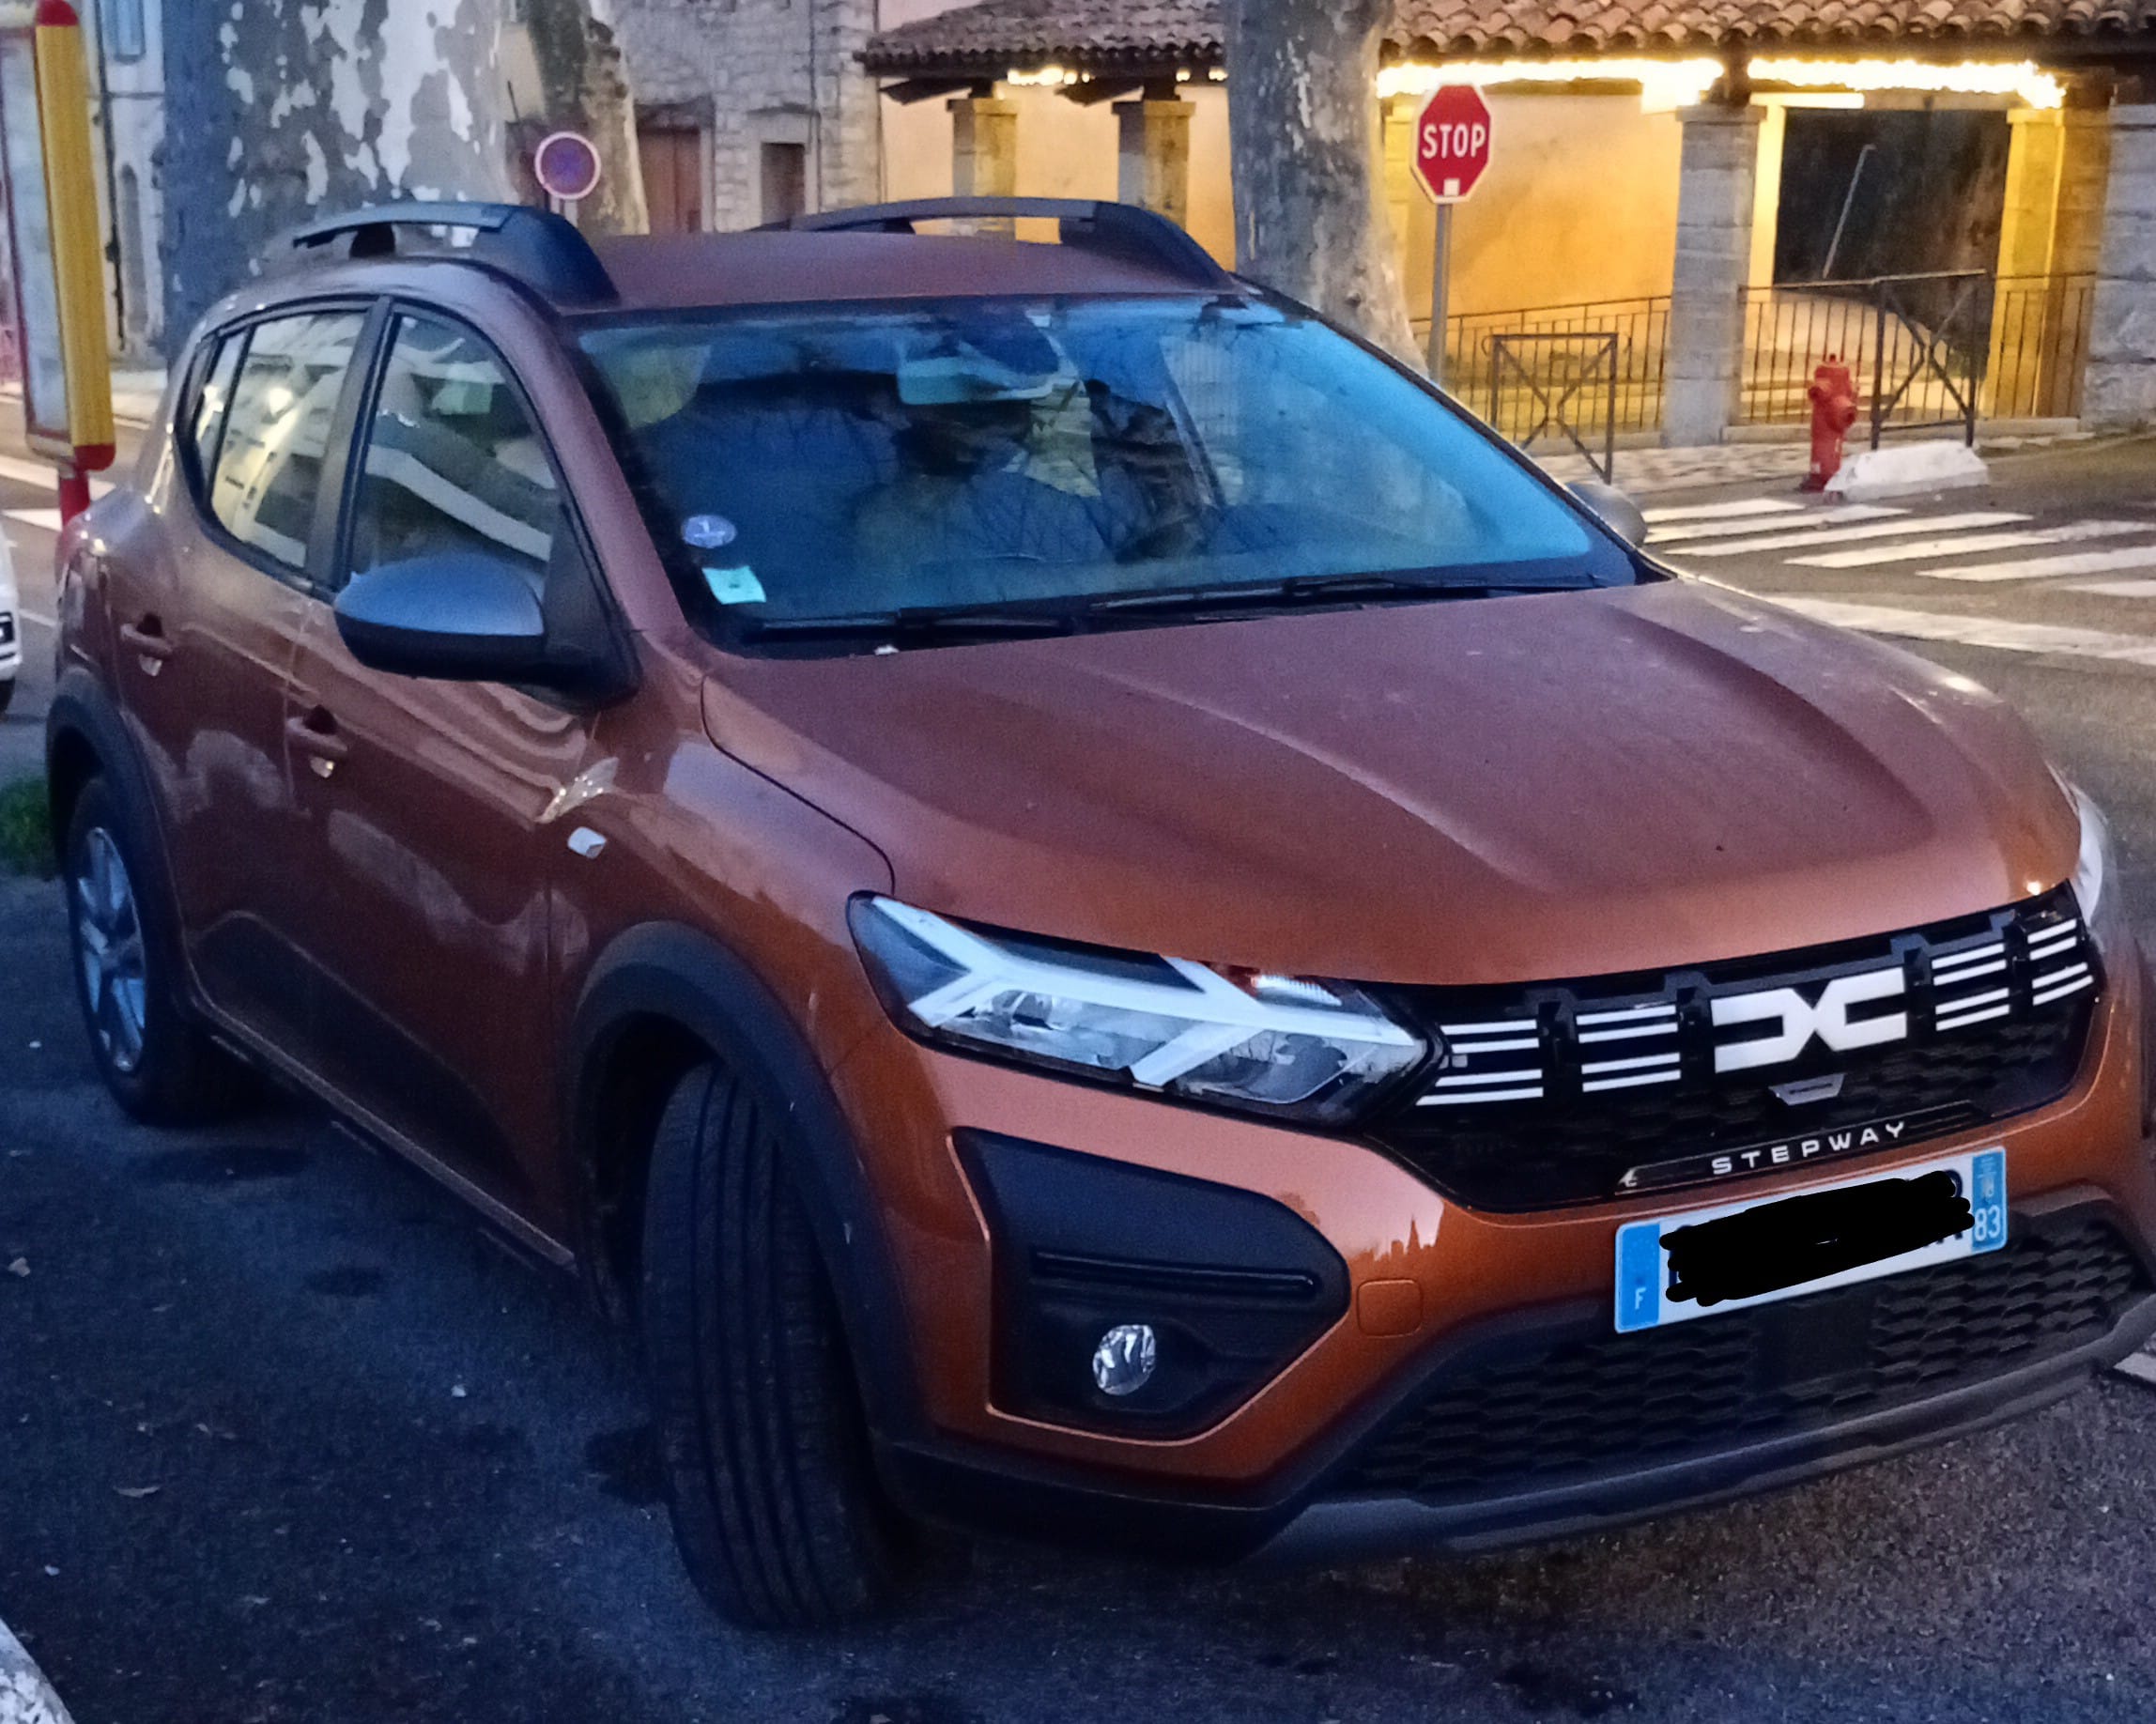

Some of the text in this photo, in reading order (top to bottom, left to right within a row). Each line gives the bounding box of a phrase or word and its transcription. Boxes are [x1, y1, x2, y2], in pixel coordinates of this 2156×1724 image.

[1422, 123, 1486, 159] STOP
[1712, 1121, 1904, 1175] STEPWAY
[1974, 1205, 2001, 1241] 83
[1635, 1287, 1646, 1310] F
